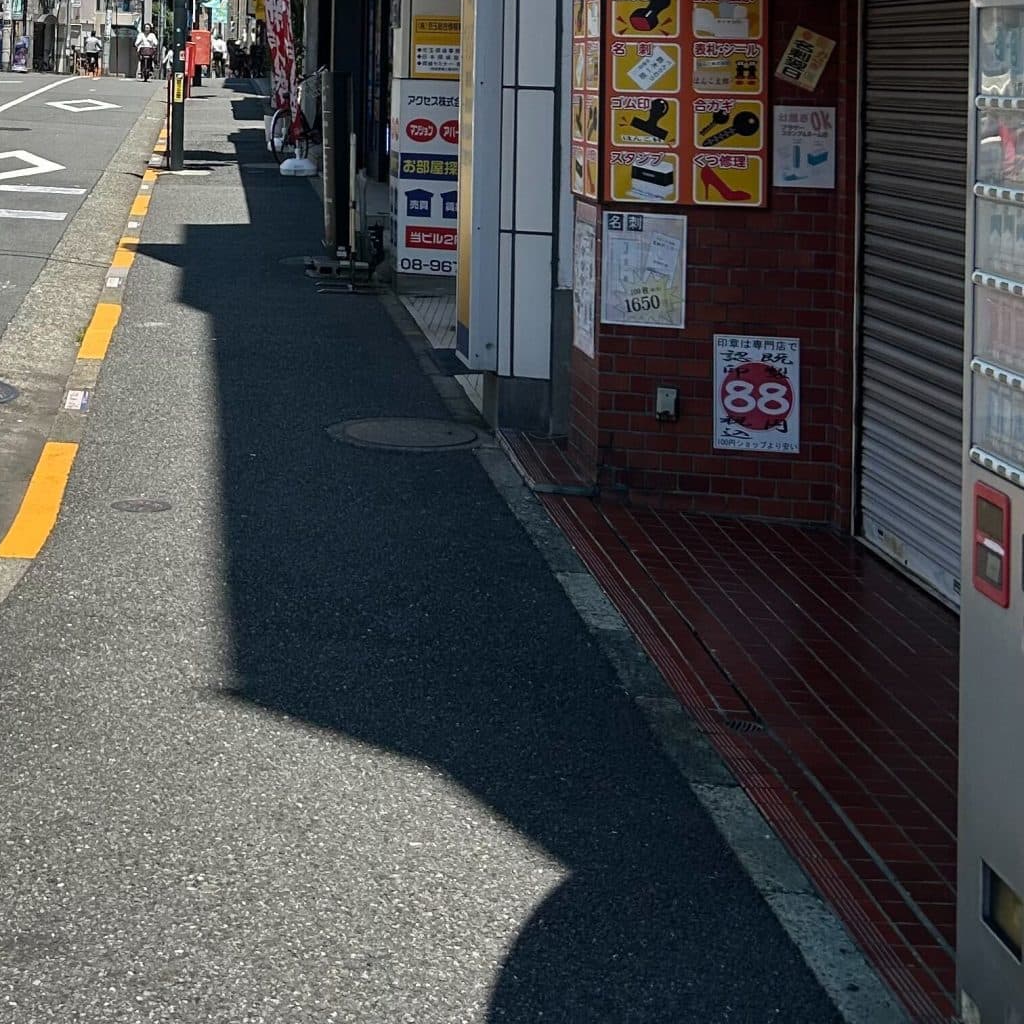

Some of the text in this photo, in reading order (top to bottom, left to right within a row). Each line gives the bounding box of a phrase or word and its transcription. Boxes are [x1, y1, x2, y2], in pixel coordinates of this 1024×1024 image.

[611, 42, 653, 57] 名刺
[694, 43, 760, 58] 表札・シール
[611, 97, 651, 110] ゴム印
[694, 100, 735, 114] 合カギ
[410, 124, 434, 137] マンション
[610, 152, 664, 166] スタンプ
[694, 155, 748, 169] くつ修理
[403, 160, 458, 175] お部屋探
[608, 213, 643, 232] 名刺
[717, 338, 798, 351] 印章は専門店で
[723, 380, 790, 415] 88
